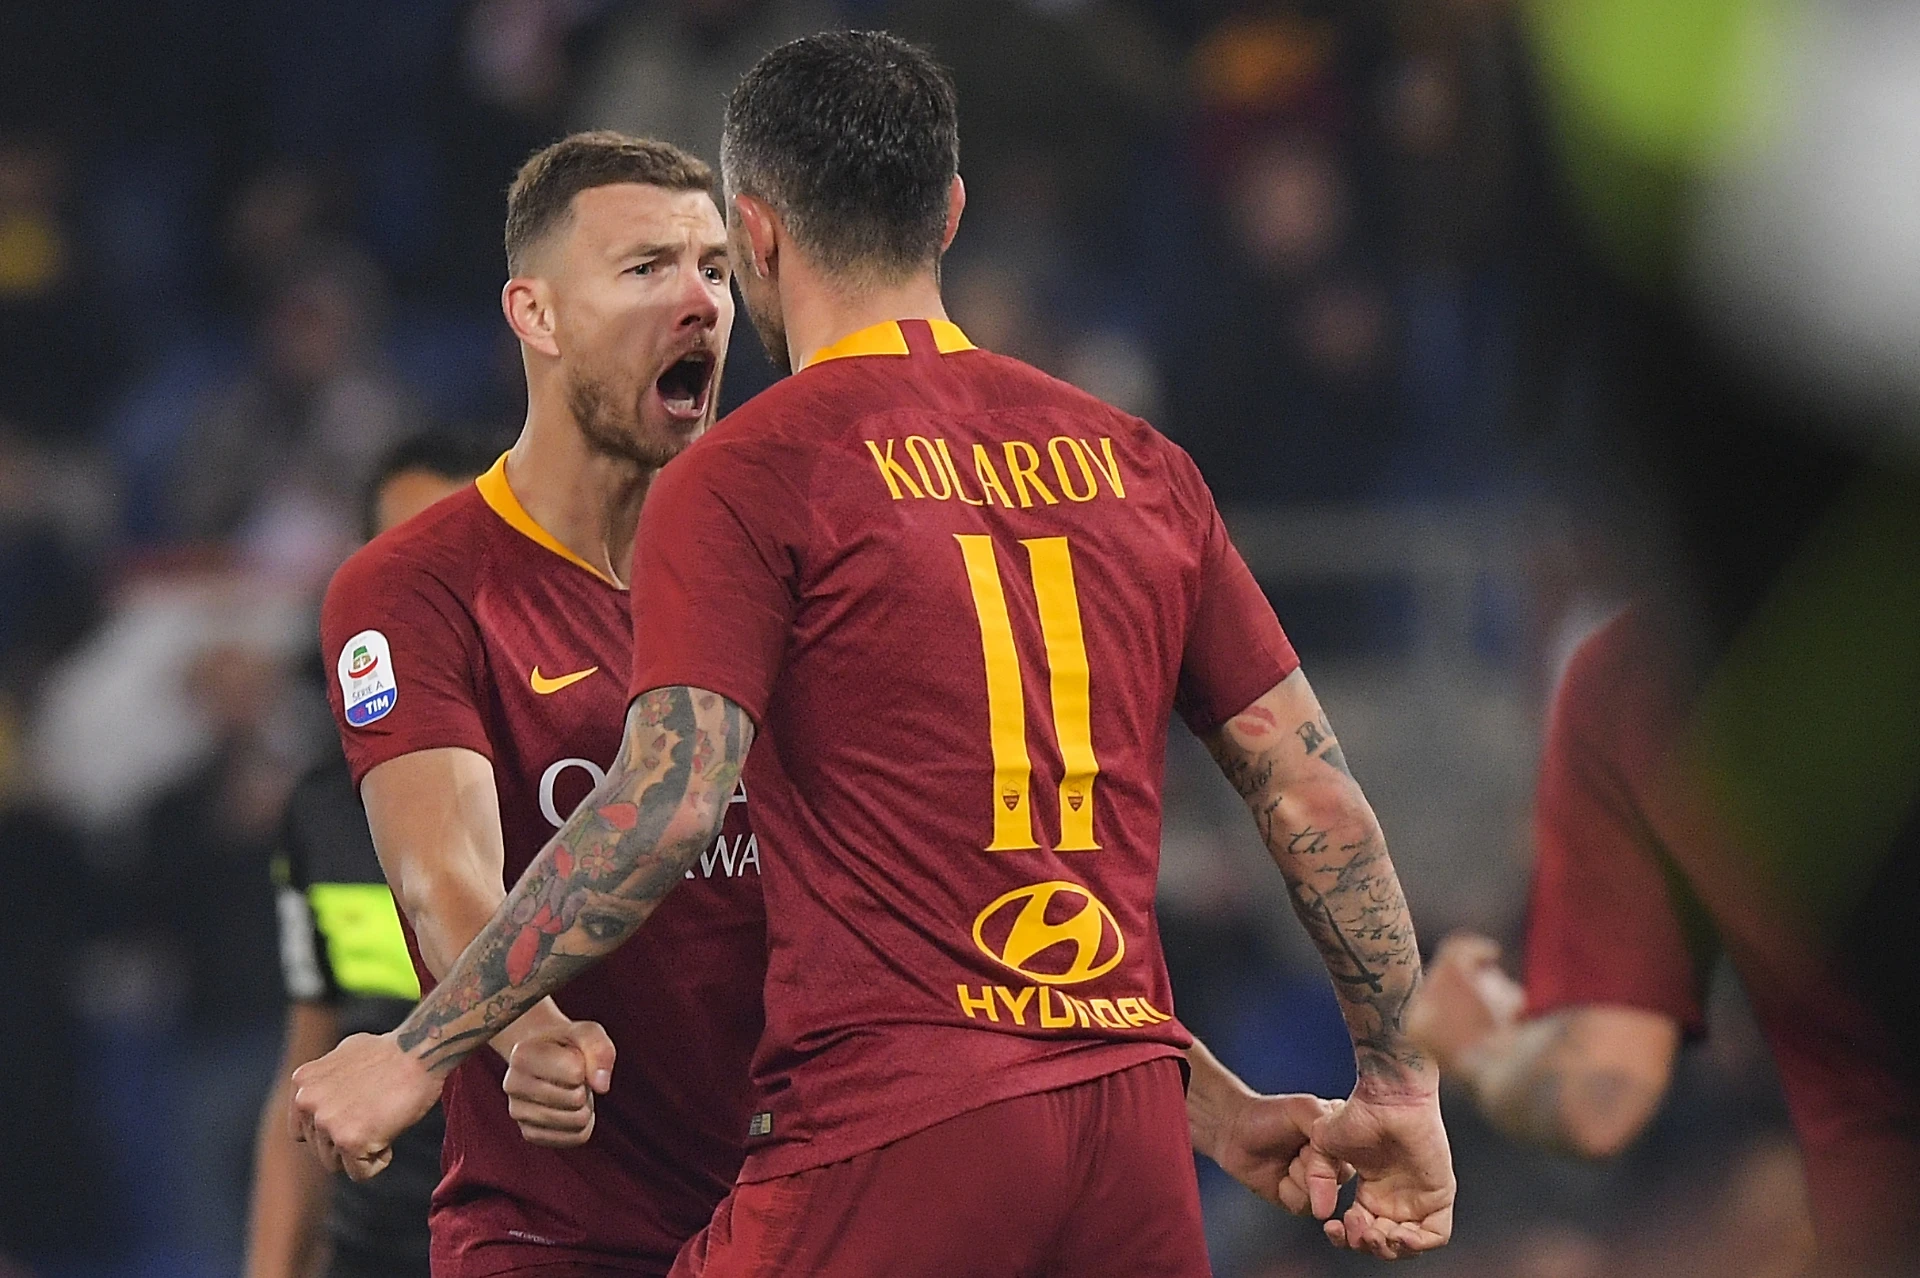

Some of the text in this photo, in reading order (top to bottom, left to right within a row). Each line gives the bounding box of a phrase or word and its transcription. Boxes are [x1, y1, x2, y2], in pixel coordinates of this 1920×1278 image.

[865, 435, 1126, 509] KOLAROV
[352, 680, 384, 702] SERIE A
[365, 695, 389, 715] TIM
[952, 533, 1103, 852] 11
[684, 832, 761, 880] WA
[957, 984, 1173, 1029] HYUNDAI
